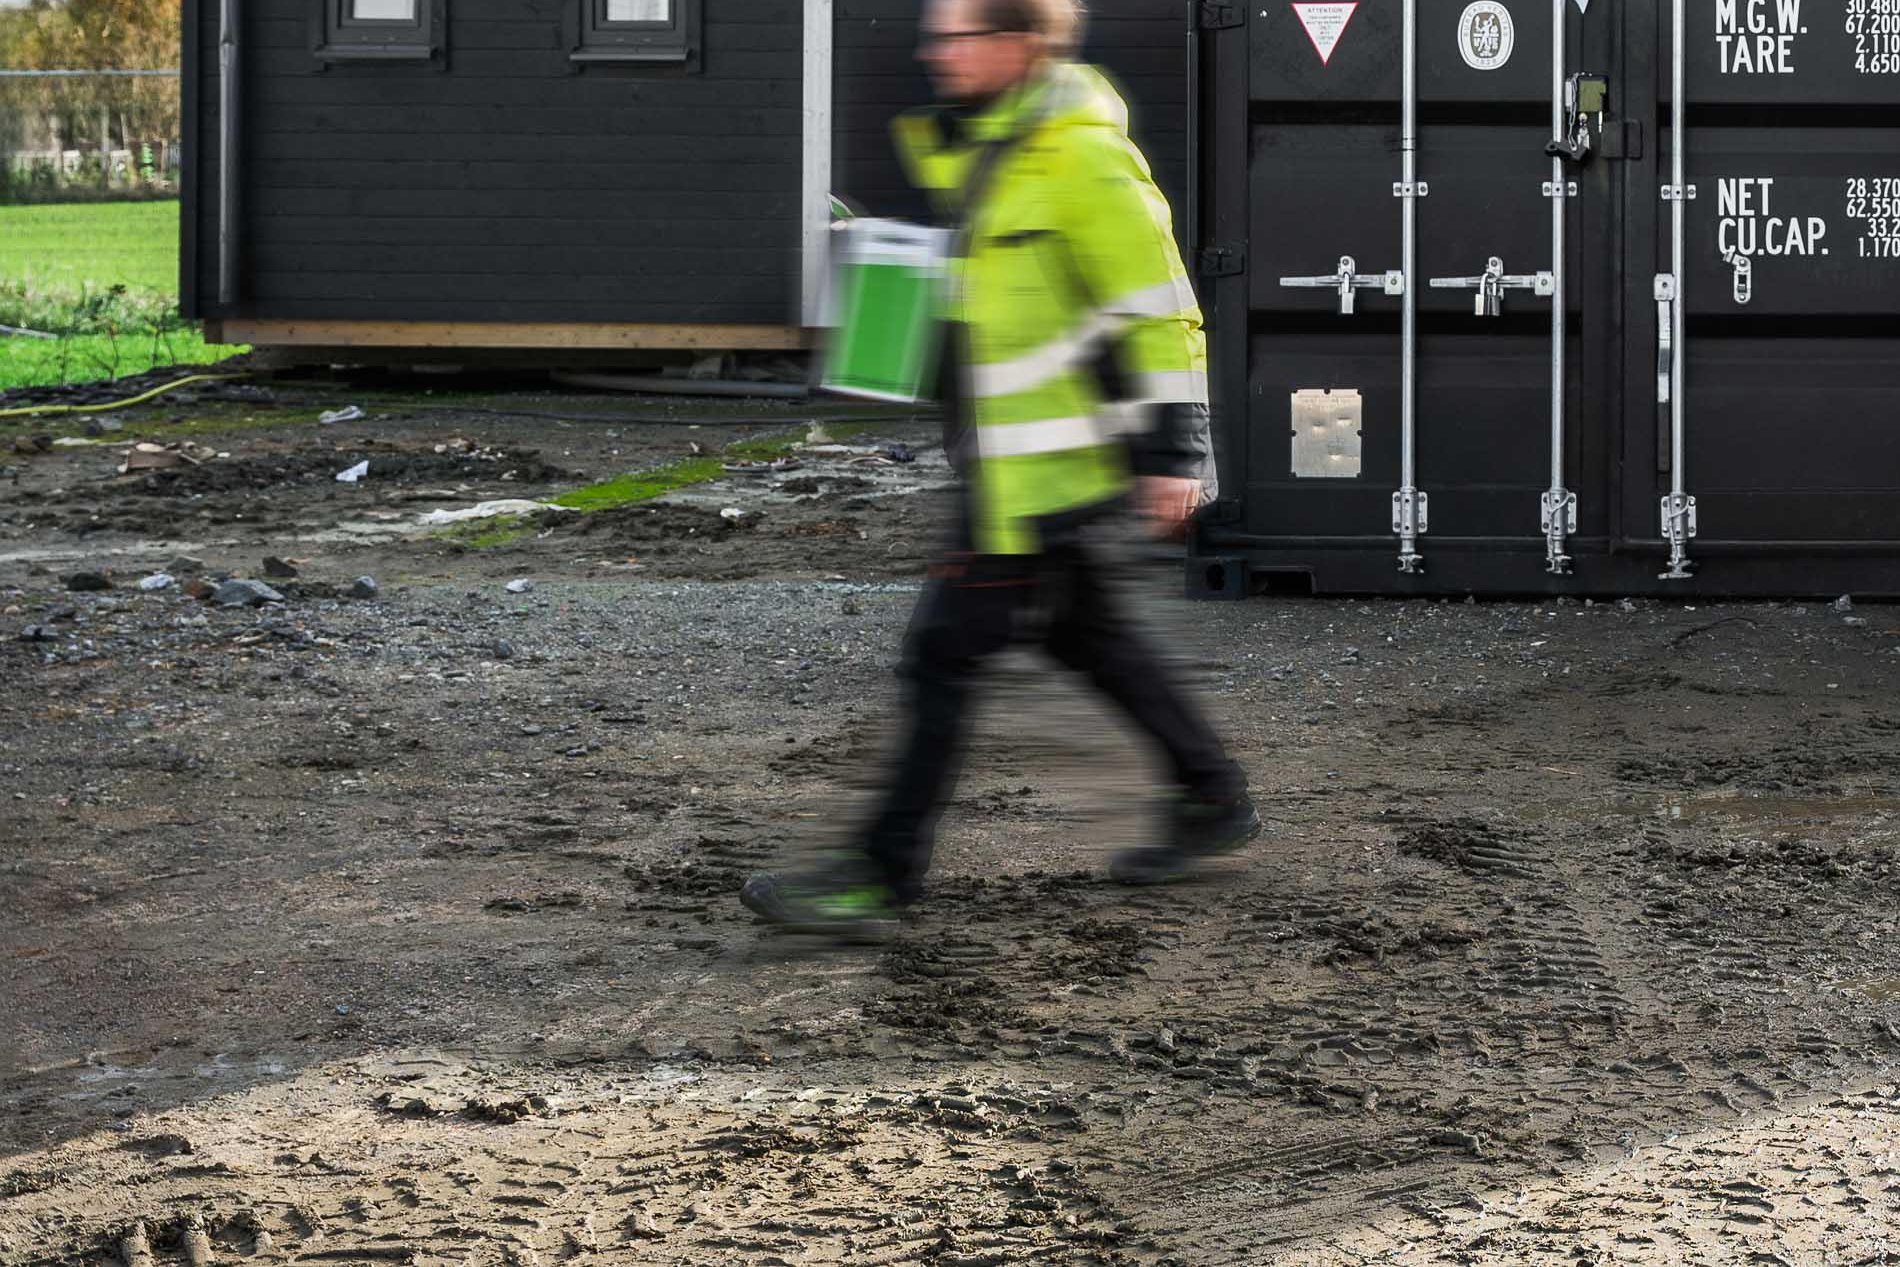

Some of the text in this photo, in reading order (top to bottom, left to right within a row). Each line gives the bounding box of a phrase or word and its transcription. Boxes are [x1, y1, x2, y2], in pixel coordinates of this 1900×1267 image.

[1845, 14, 1900, 34] 67,200
[1715, 35, 1795, 74] TARE
[1855, 34, 1900, 54] 2,110
[1854, 54, 1900, 74] 4,650
[1718, 178, 1774, 216] NET
[1718, 217, 1829, 255] CU.CAP.
